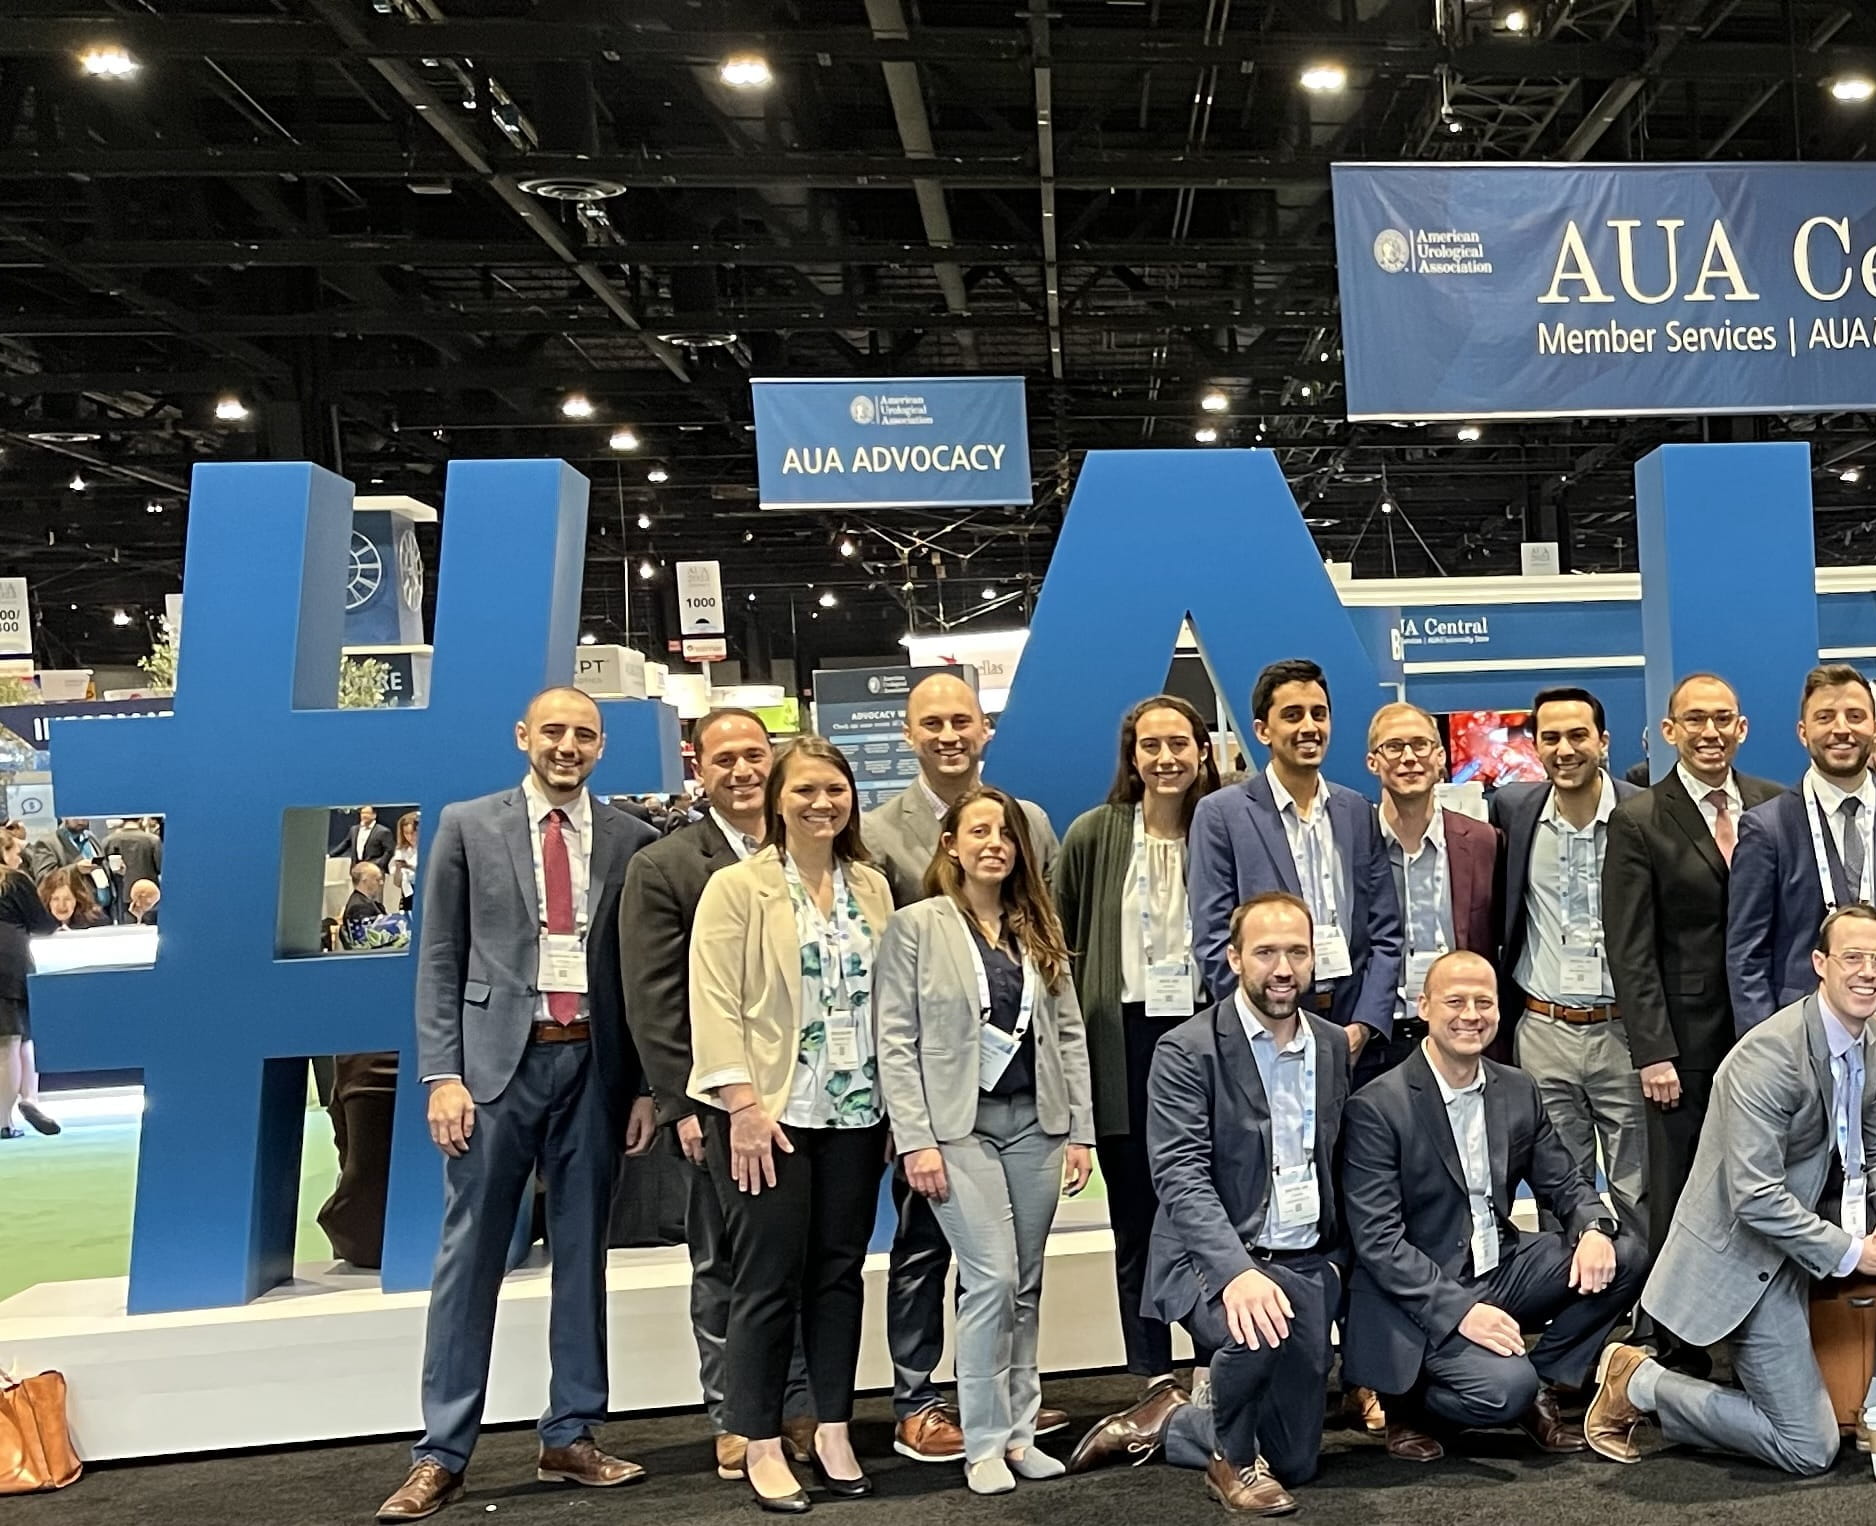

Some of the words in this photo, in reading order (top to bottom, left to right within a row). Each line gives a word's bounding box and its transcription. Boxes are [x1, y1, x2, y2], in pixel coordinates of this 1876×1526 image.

[1416, 228, 1481, 243] American
[1417, 244, 1485, 261] Urological
[1536, 219, 1760, 304] AUA
[1418, 259, 1493, 274] Association
[1537, 319, 1656, 355] Member
[1665, 317, 1777, 352] Services
[782, 447, 845, 475] AUA
[852, 443, 1006, 473] ADVOCACY
[686, 597, 716, 608] 1000
[1424, 617, 1488, 636] Central
